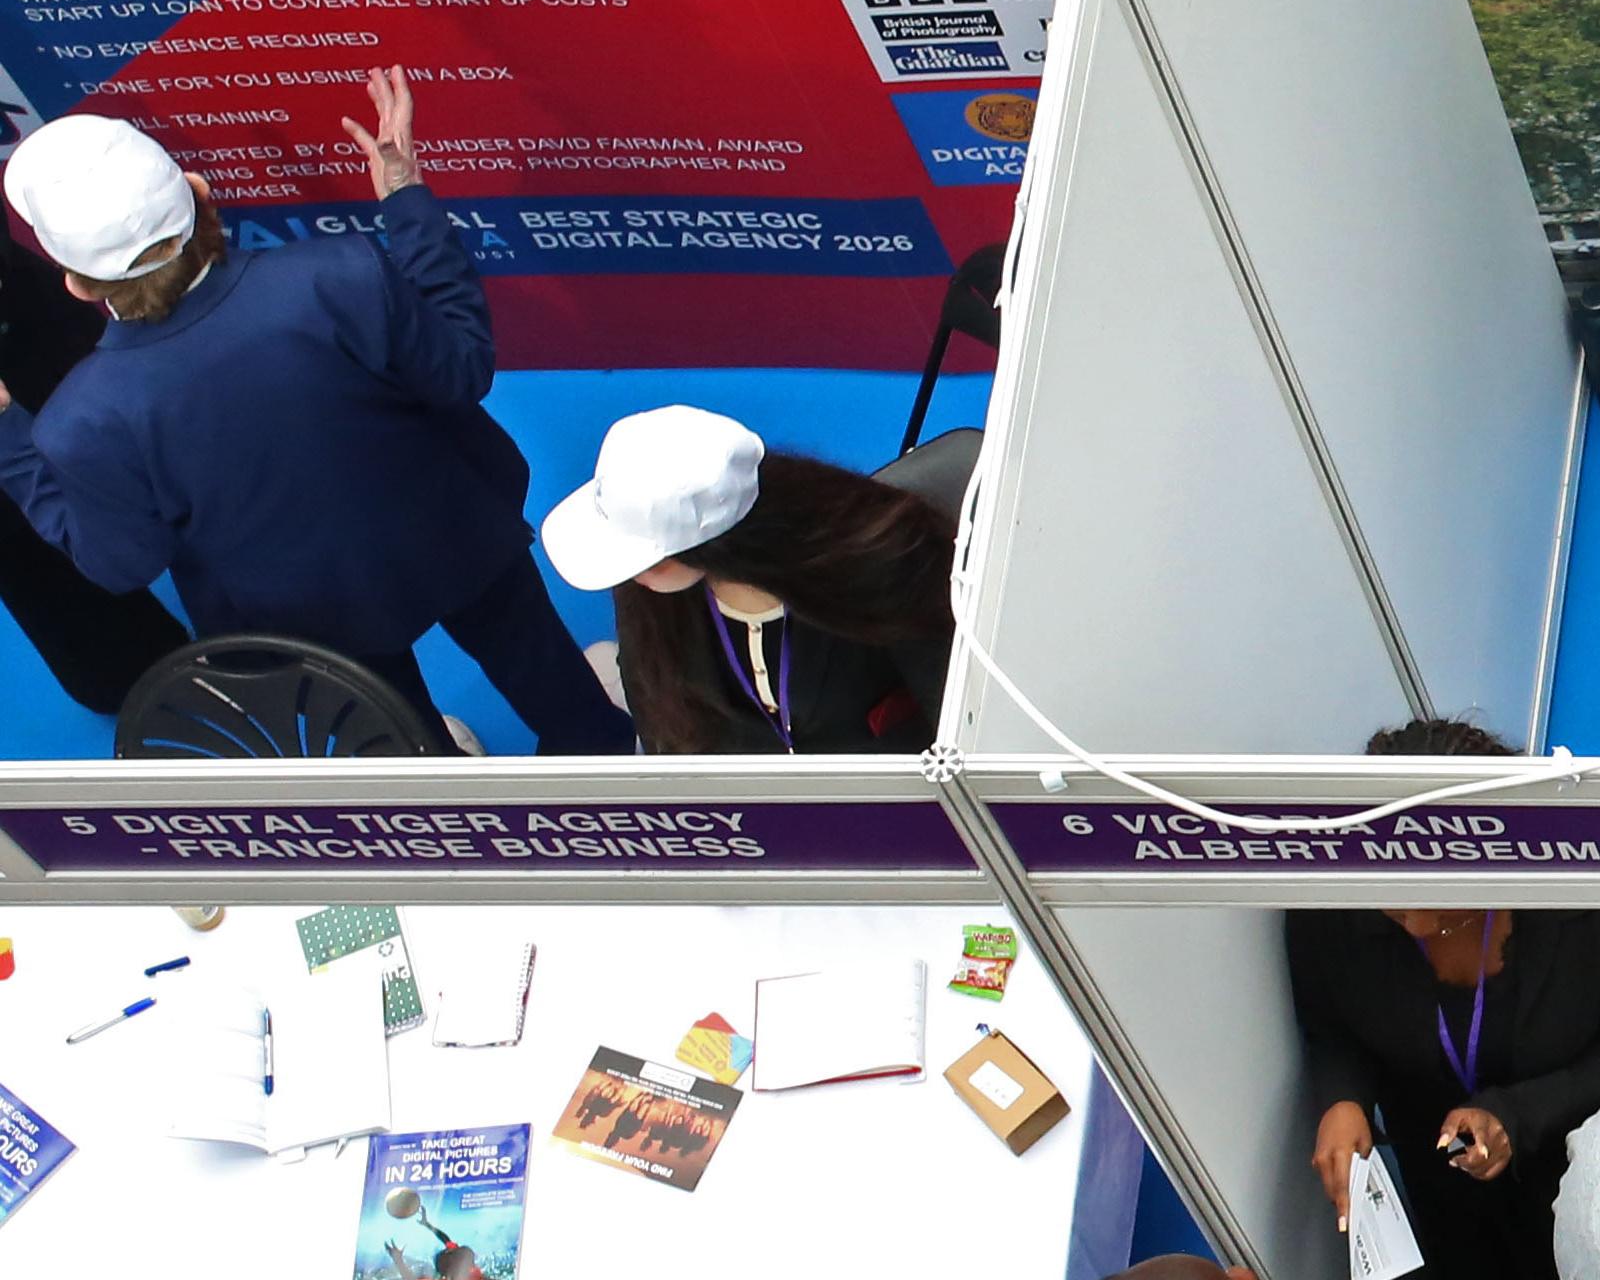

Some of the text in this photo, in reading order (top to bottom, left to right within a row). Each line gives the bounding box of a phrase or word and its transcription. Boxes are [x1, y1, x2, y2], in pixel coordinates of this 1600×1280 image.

[24, 5, 103, 22] START
[110, 3, 146, 18] UP
[883, 15, 932, 28] British
[882, 23, 997, 38] of Photography
[53, 45, 93, 59] NO
[246, 31, 379, 49] REQUIRED
[895, 53, 1005, 71] Guardian
[79, 66, 514, 95] DONE FOR YOU BUSINE IN A BOX
[169, 109, 290, 128] TRAINING
[294, 143, 325, 157] BY
[413, 137, 513, 154] OUNDER
[517, 137, 591, 151] DAVID
[596, 137, 712, 153] FAIRMAN,
[717, 138, 803, 153] AWARD
[931, 146, 1027, 162] DIGITA
[266, 160, 368, 181] CREATIV
[415, 155, 523, 172] RECTOR,
[526, 156, 732, 170] PHOTOGRAPHER
[737, 158, 786, 171] AND
[519, 210, 610, 228] BEST
[622, 210, 822, 230] STRATEGIC
[531, 231, 673, 249] DIGITAL
[680, 231, 822, 250] AGENCY
[833, 234, 914, 252] 2026
[62, 811, 743, 835] 5 DIGITAL TIGER AGENCY
[1062, 814, 1094, 835] 6
[1393, 815, 1506, 836] AND
[168, 838, 483, 858] FRANCHISE
[490, 836, 766, 858] BUSINESS
[1135, 839, 1600, 861] ALBERT MUSEUM
[421, 1138, 448, 1150] TAKE
[449, 1135, 486, 1149] GREAT
[402, 1145, 498, 1163] DIGITAL PICTURES
[385, 1166, 406, 1184] IN
[410, 1165, 433, 1183] 24
[439, 1157, 512, 1180] HOURS
